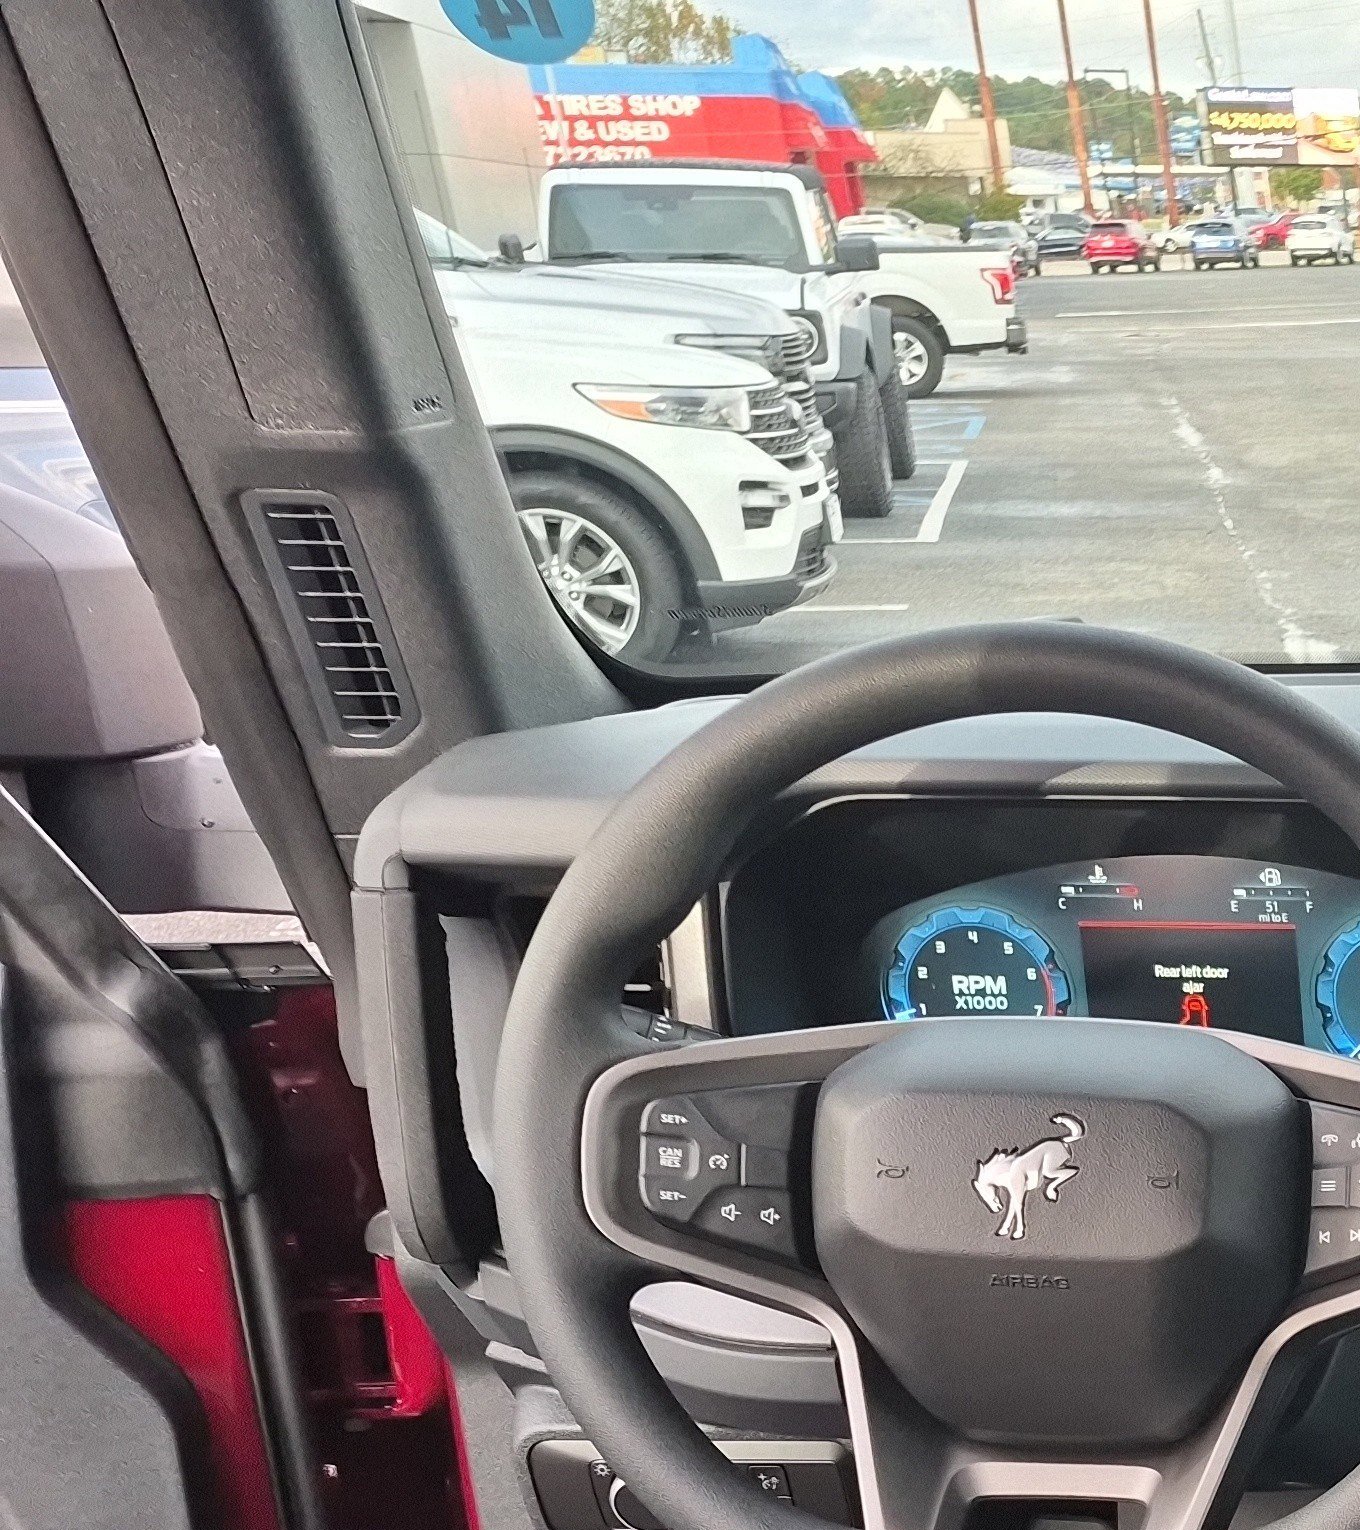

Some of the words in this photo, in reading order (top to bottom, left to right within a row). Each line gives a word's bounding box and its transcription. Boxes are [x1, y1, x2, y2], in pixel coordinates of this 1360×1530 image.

[543, 94, 625, 116] TIRES
[627, 95, 701, 117] SHOP
[573, 119, 596, 140] &
[596, 120, 671, 142] USED
[1058, 898, 1066, 910] C
[1134, 899, 1142, 911] H
[1231, 901, 1239, 912] E
[1265, 901, 1278, 912] 51
[1306, 902, 1314, 913] F
[1271, 914, 1281, 922] to
[968, 930, 979, 944] 4
[935, 940, 946, 954] 3
[1003, 942, 1014, 955] 5
[917, 966, 928, 979] 2
[1026, 968, 1037, 980] 6
[1154, 965, 1180, 978] Rear
[1182, 965, 1202, 978] left
[1202, 966, 1229, 979] door
[951, 974, 1007, 995] RPM
[1182, 981, 1204, 994] ajar
[918, 1003, 927, 1016] 1
[955, 996, 1008, 1010] X1000
[1034, 1005, 1044, 1018] 7
[658, 1146, 683, 1158] CAN
[660, 1158, 682, 1168] RES
[989, 1274, 1070, 1290] AIRBAG
